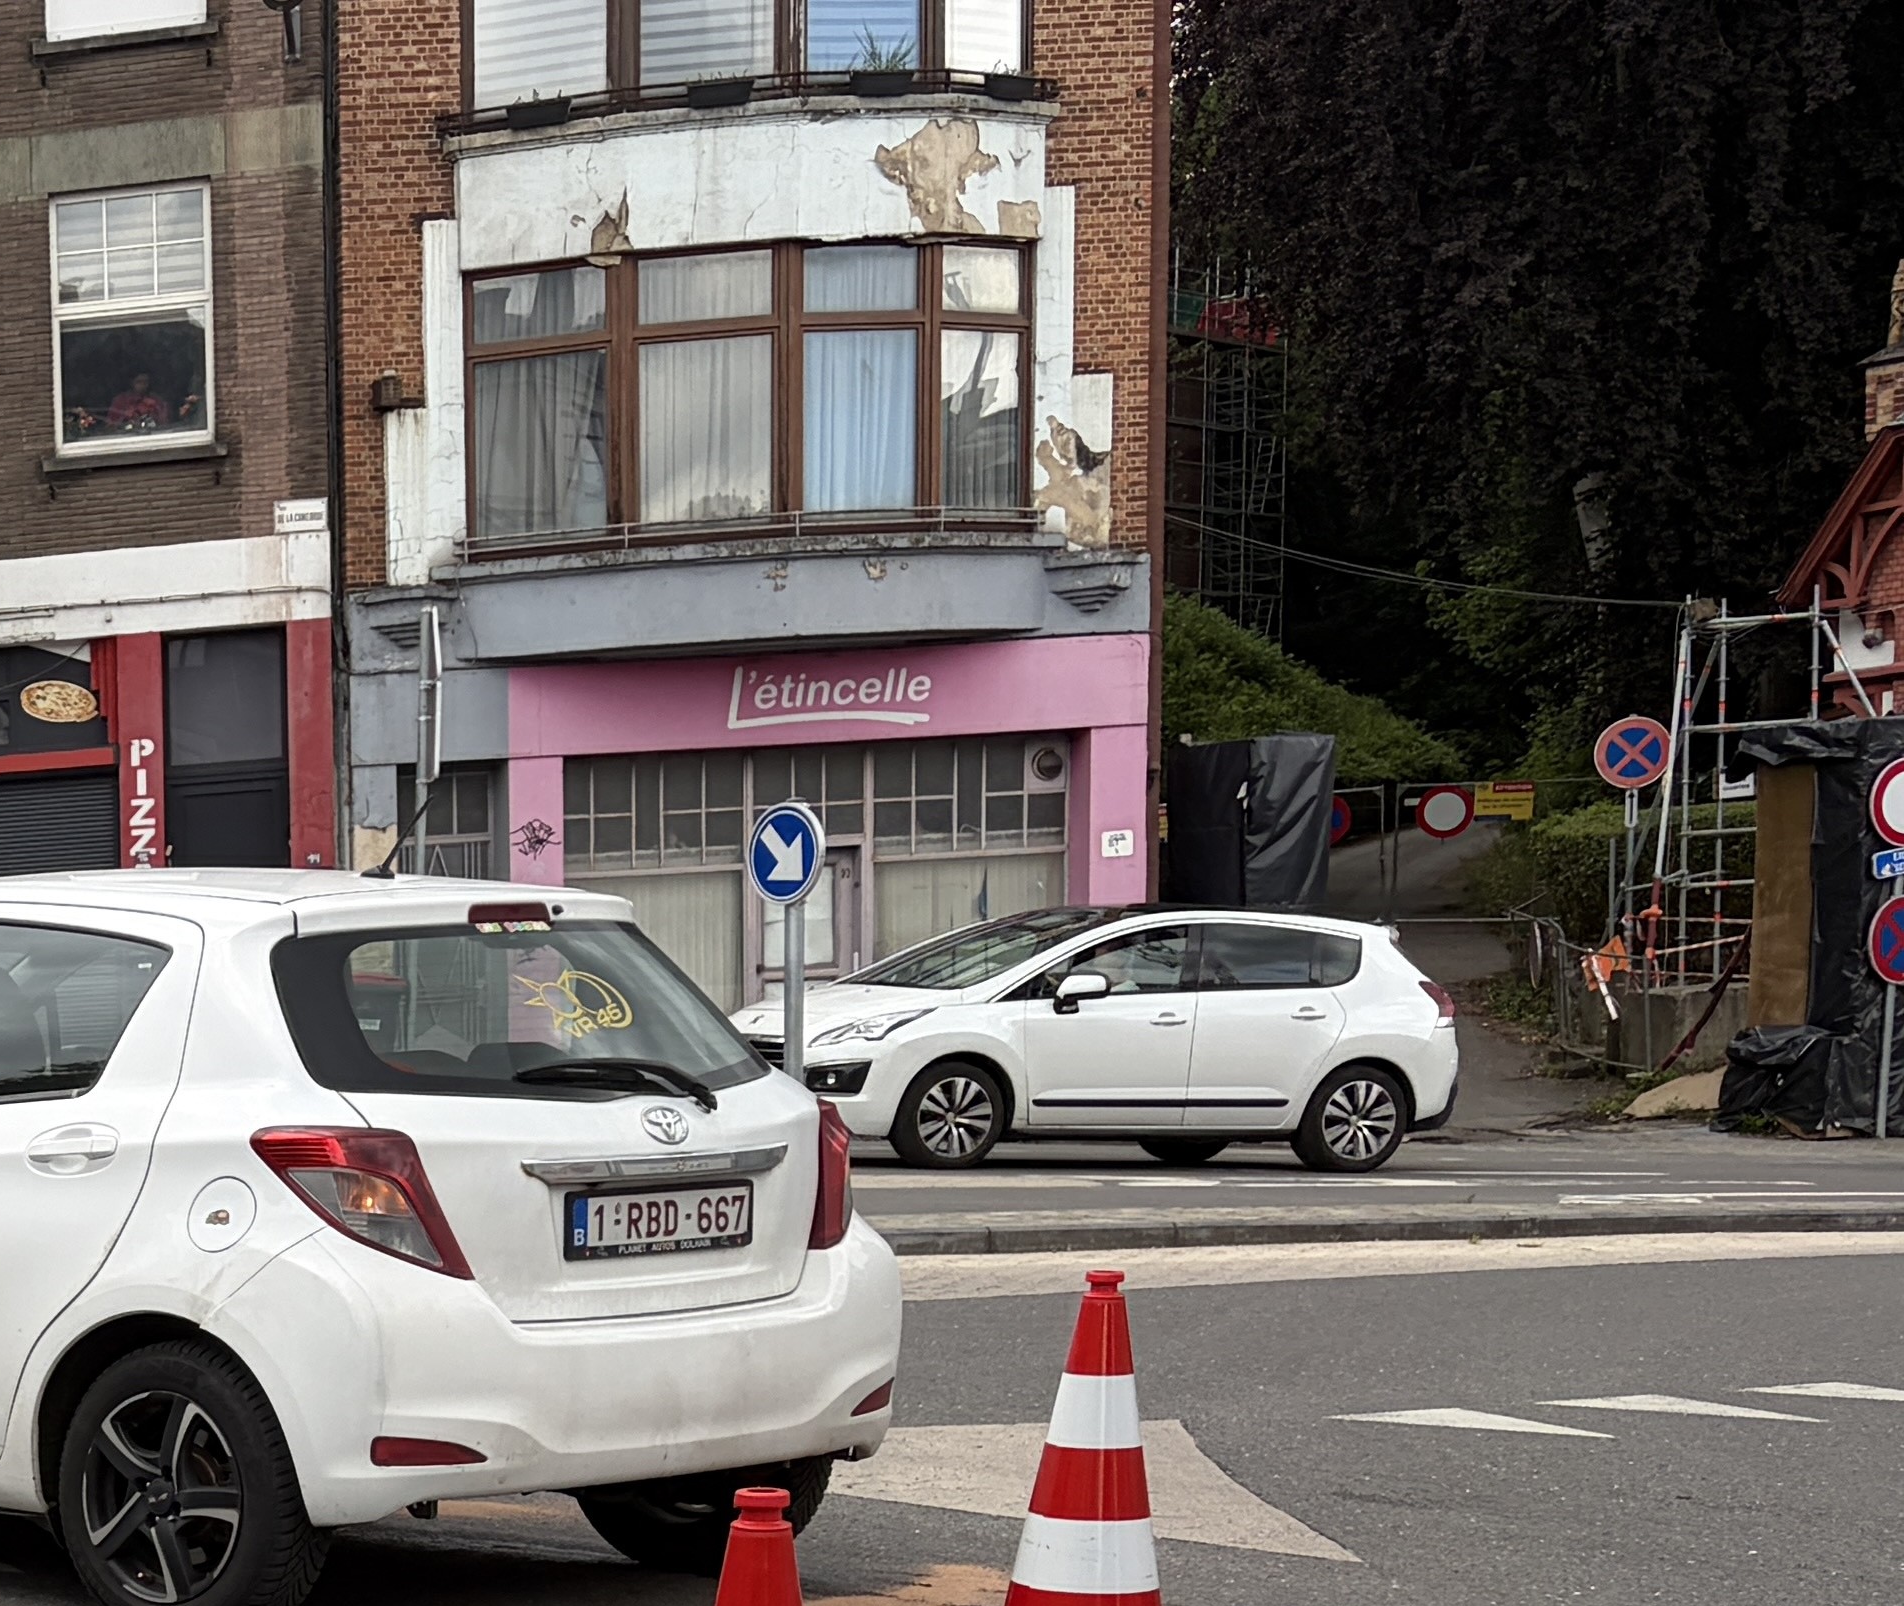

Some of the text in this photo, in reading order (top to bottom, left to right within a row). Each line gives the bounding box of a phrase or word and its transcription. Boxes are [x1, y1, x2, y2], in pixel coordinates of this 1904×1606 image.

[727, 665, 932, 729] L'étincelle
[129, 738, 157, 869] PIZZ
[573, 1228, 586, 1247] B
[593, 1194, 746, 1242] 1-RBD-667
